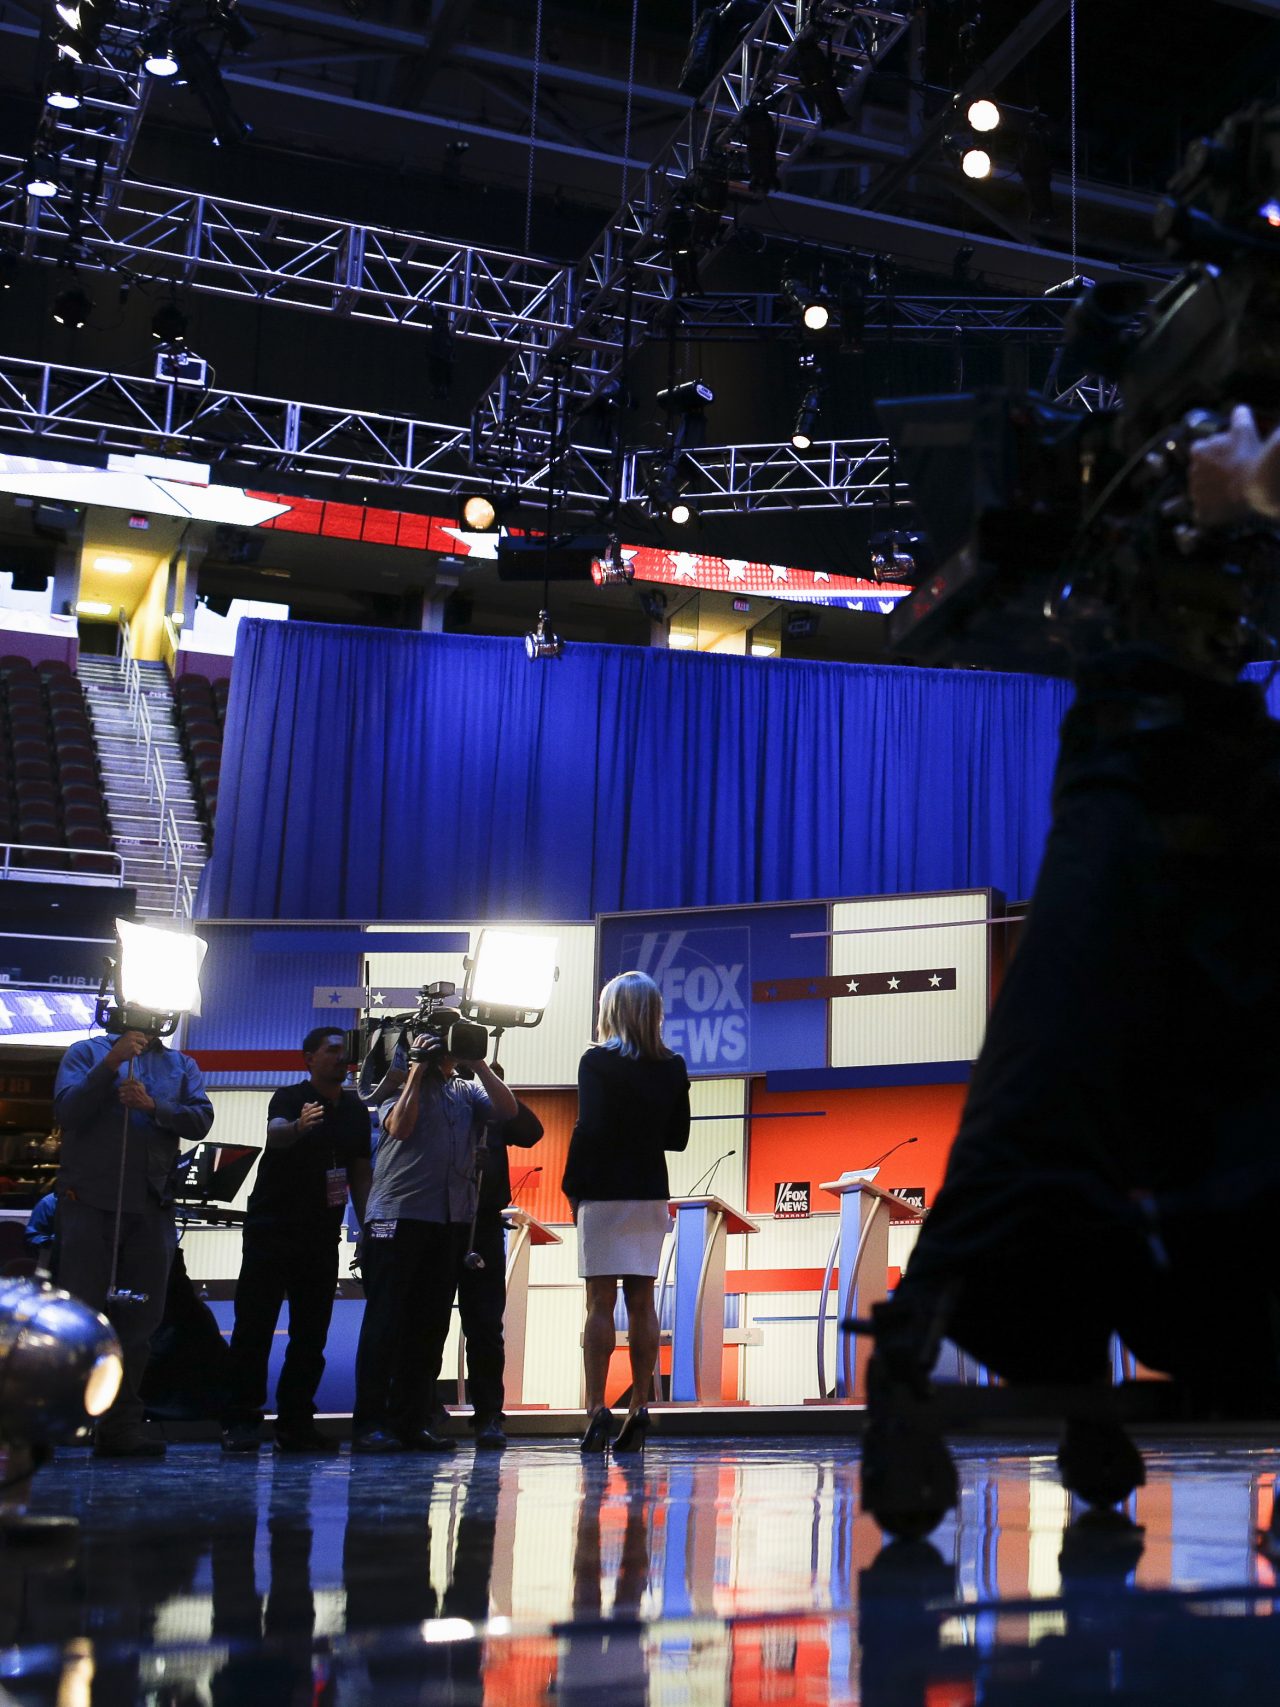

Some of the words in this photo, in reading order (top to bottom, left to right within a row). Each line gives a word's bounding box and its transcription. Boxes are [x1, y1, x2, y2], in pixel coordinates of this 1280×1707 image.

[662, 964, 744, 1014] FOX
[661, 1014, 747, 1064] EWS
[785, 1190, 808, 1202] FOX
[901, 1195, 923, 1208] OX
[779, 1201, 809, 1212] NEWS
